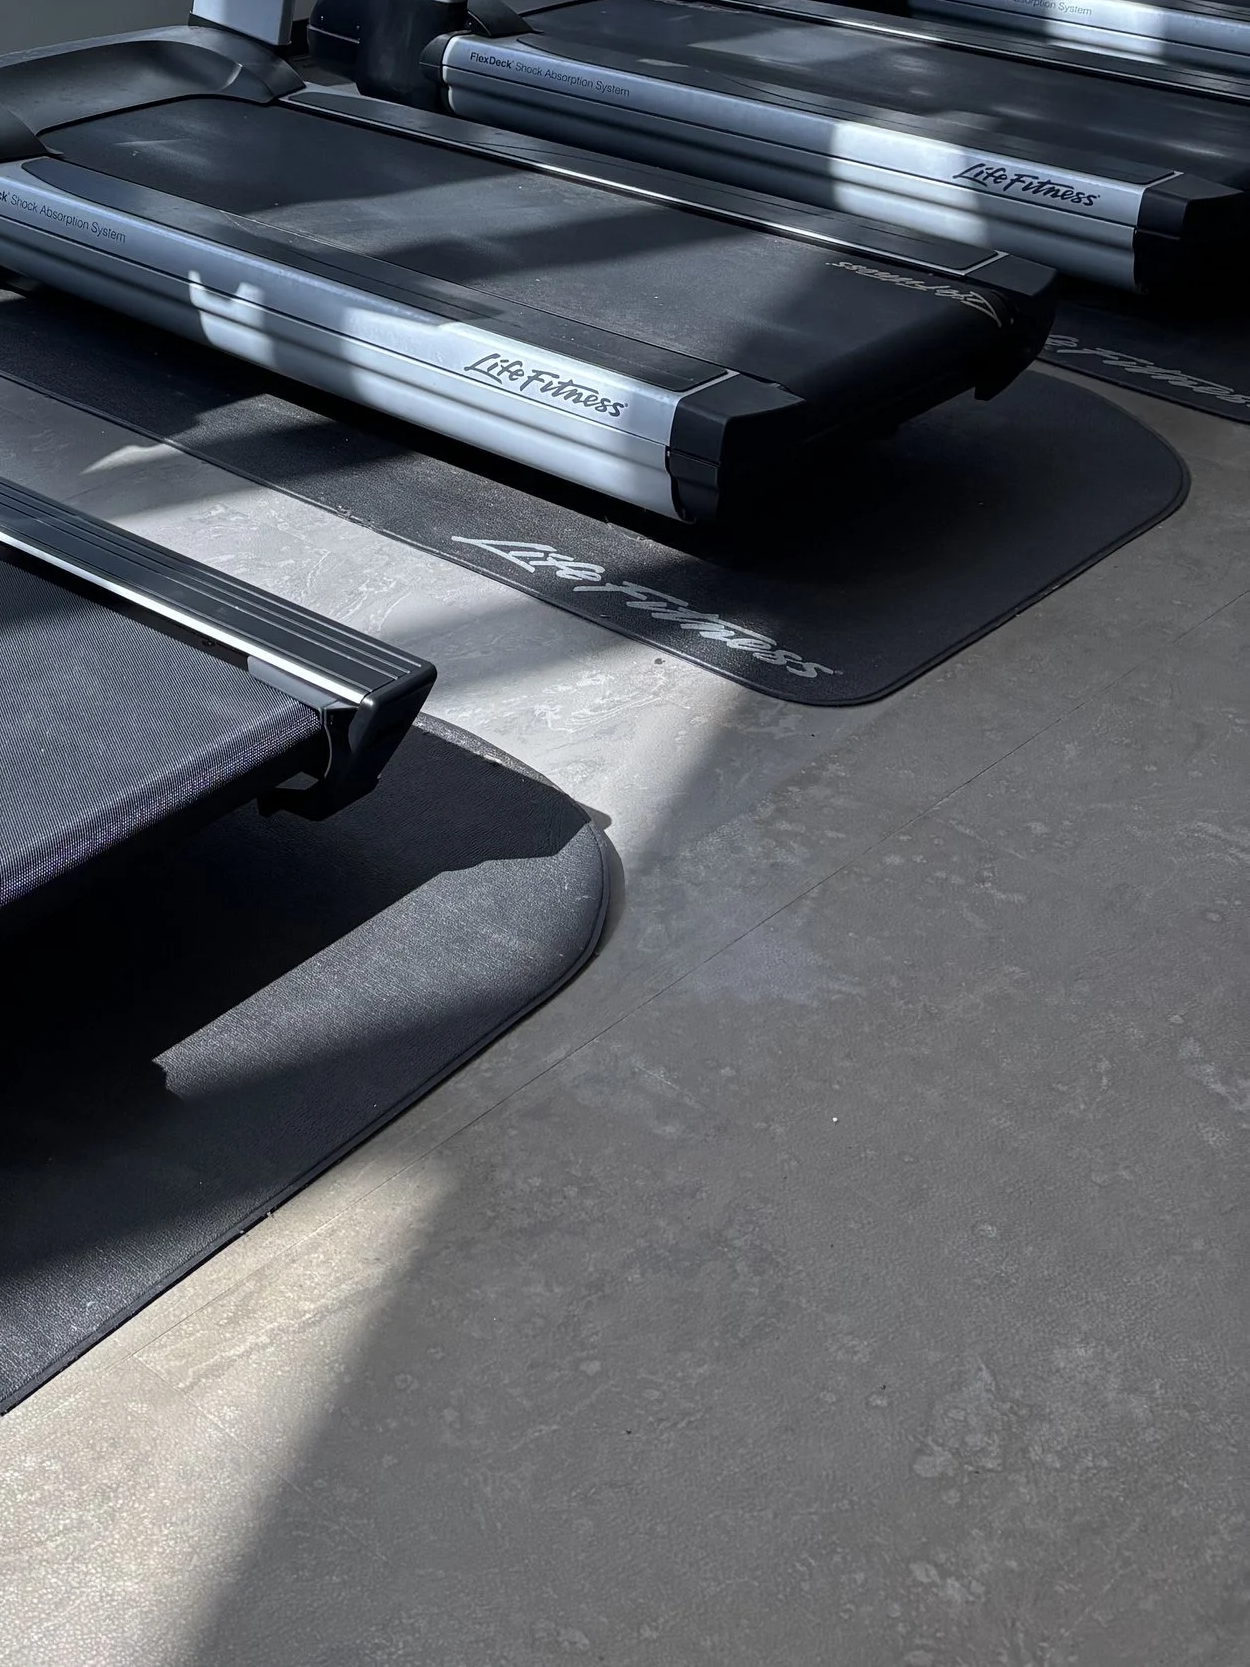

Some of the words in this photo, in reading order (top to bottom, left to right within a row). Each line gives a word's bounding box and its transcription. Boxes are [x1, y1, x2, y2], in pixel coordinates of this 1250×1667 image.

[1058, 2, 1093, 16] System
[515, 61, 543, 76] Shock
[544, 69, 594, 88] Absorption
[595, 80, 630, 97] System
[10, 194, 38, 213] Shock
[39, 205, 89, 230] Absorption
[90, 221, 126, 243] System
